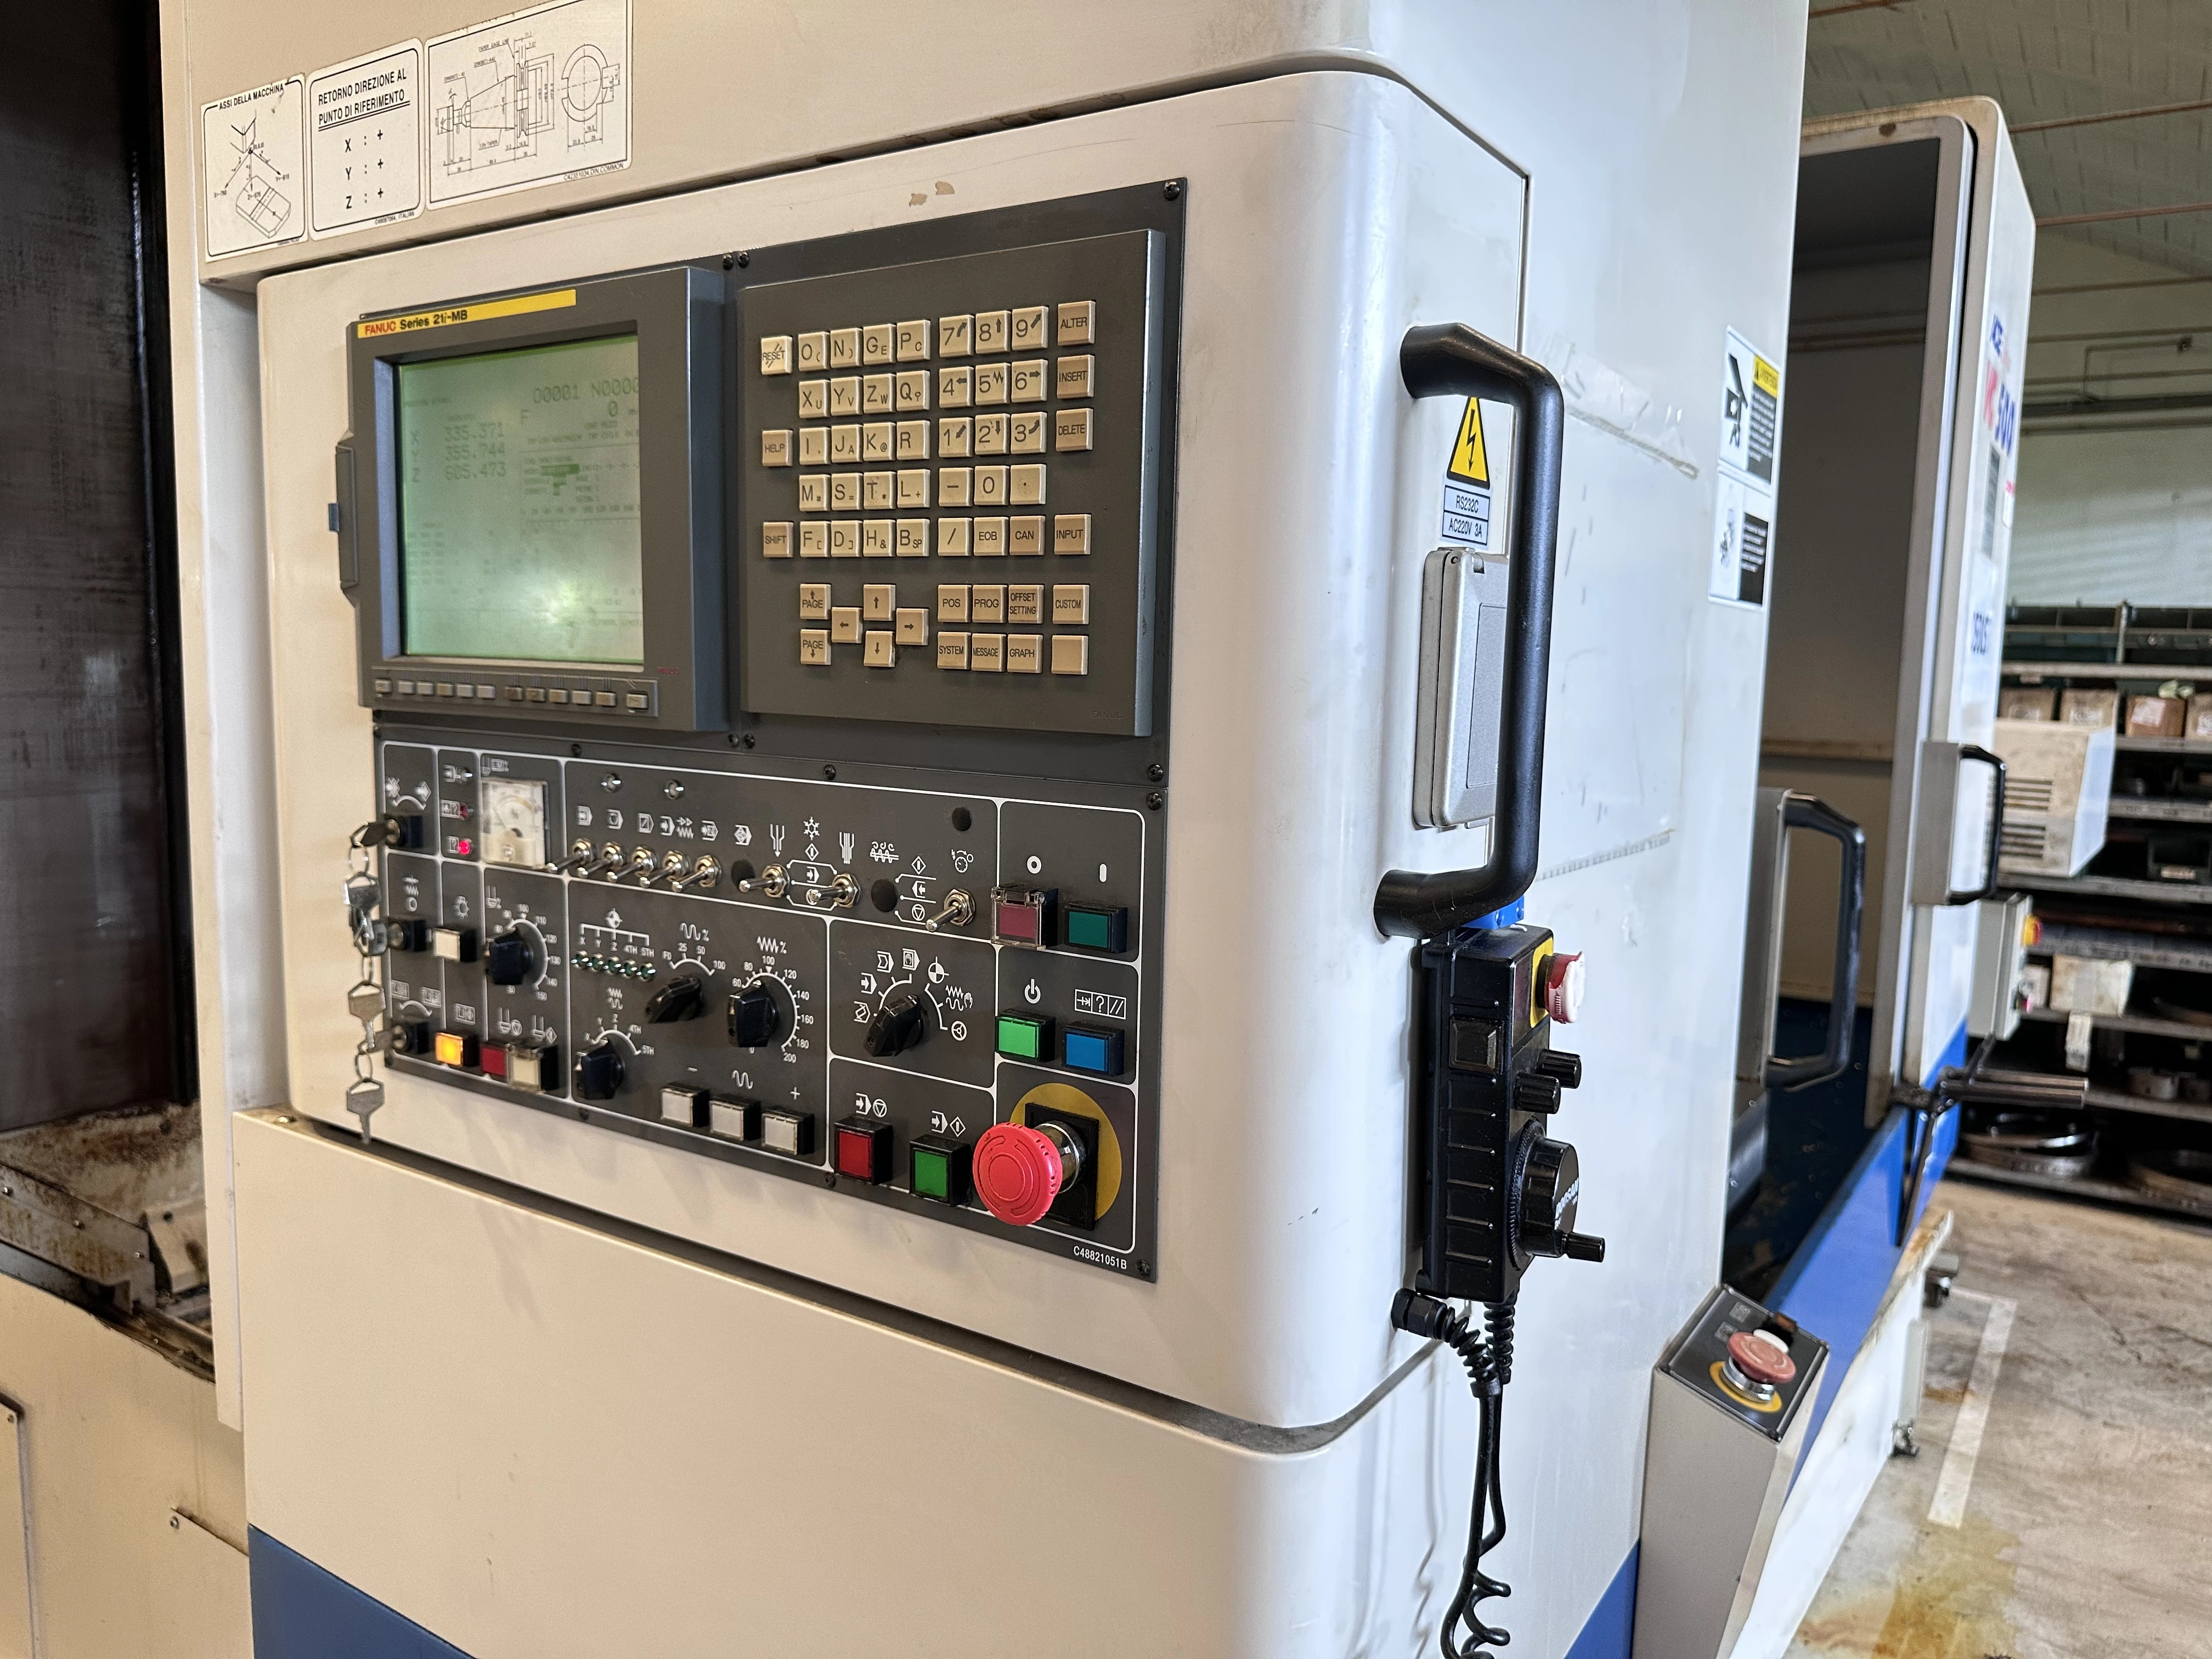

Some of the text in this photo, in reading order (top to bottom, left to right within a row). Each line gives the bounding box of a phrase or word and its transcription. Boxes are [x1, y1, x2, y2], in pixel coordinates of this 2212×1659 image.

[318, 68, 407, 106] RETORNO DIREZIONE AL
[219, 83, 284, 110] ASSI DELLA MACCHINA
[319, 89, 404, 125] PUNTO DI RIFERIMENTO
[345, 138, 352, 153] X
[346, 167, 352, 180] Y
[600, 163, 624, 173] COMMON
[346, 196, 352, 209] Z
[365, 310, 468, 336] FANUC Series 21i-MB
[1016, 319, 1028, 338] 9
[1060, 317, 1087, 329] ALTER
[943, 327, 955, 346] 7
[979, 323, 991, 342] 8
[763, 350, 785, 361] RESET
[1015, 371, 1028, 391] 6
[1059, 370, 1087, 383] INSERT
[943, 379, 955, 396] 4
[979, 375, 991, 393] 5
[445, 421, 504, 442] 335.371
[979, 425, 991, 443] 2
[1014, 424, 1027, 443] 3
[1058, 424, 1085, 436] DELETE
[900, 432, 911, 449] R
[944, 428, 951, 446] 1
[765, 444, 785, 453] HELP
[1456, 495, 1479, 513] RS232C
[1449, 517, 1482, 538] AC220V 3A
[979, 531, 997, 541] EOB
[1015, 531, 1034, 540] CAN
[1056, 529, 1084, 539] INPUT
[765, 535, 786, 545] SHIFT
[943, 598, 961, 608] POS
[974, 598, 999, 608] PROG
[1011, 593, 1035, 602] OFFSET
[802, 600, 823, 608] PAGE
[1056, 599, 1081, 609] CUSTOM
[1009, 606, 1036, 615] SETTING
[803, 641, 823, 650] PAGE
[939, 646, 964, 655] SYSTEM
[973, 647, 998, 657] MESSAGE
[1009, 649, 1034, 658] GRAPH
[610, 941, 617, 952] Z
[624, 945, 638, 955] 4TH
[678, 942, 687, 952] 25
[696, 945, 706, 955] 50
[713, 960, 726, 970] 100
[762, 955, 775, 966] 100
[743, 962, 753, 971] 80
[784, 969, 797, 979] 120
[796, 990, 810, 1001] 140
[800, 1014, 814, 1025] 160
[629, 1024, 642, 1035] 4TH
[796, 1039, 809, 1049] 180
[783, 1053, 797, 1063] 200
[1074, 1246, 1127, 1269] C48821051B
